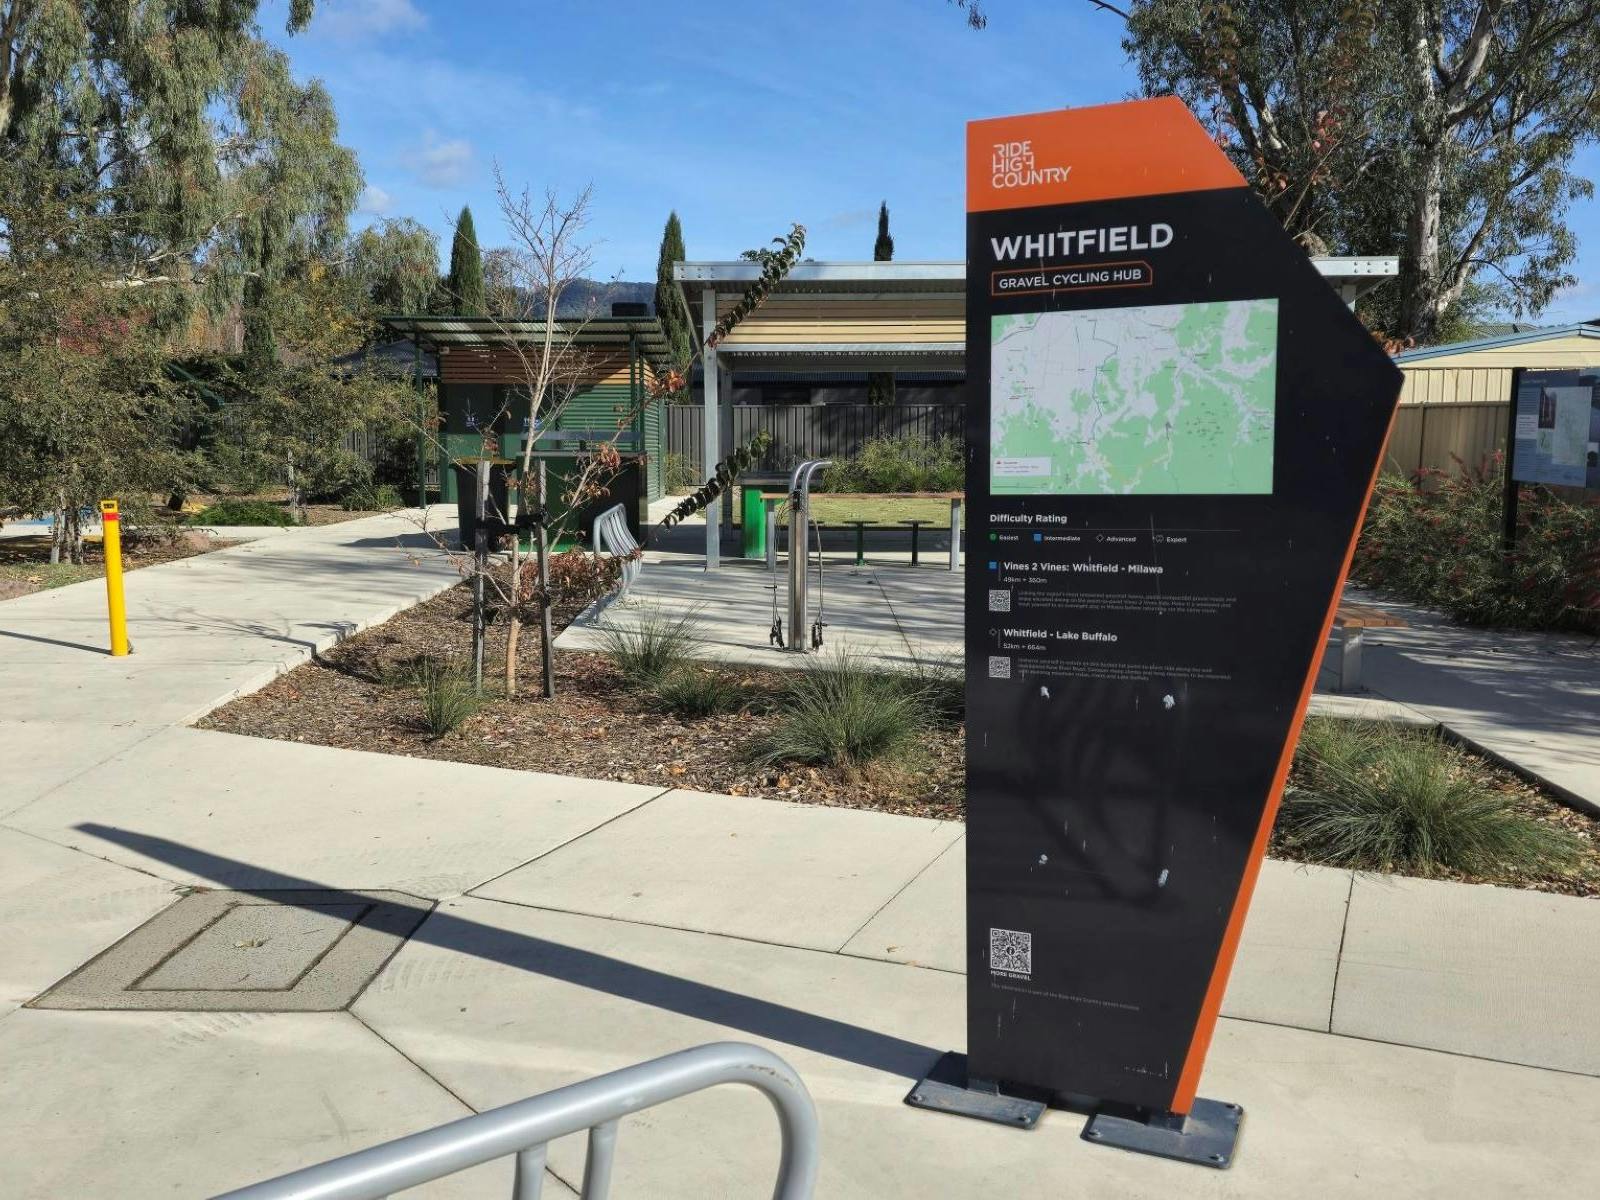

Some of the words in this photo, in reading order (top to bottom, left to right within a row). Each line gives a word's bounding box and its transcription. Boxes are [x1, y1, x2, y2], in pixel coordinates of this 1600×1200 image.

[993, 140, 1033, 157] RIDE
[992, 154, 1034, 174] HIGH
[992, 166, 1072, 188] COUNTRY
[991, 223, 1174, 261] WHITFIELD
[999, 276, 1050, 289] GRAVEL
[1053, 271, 1110, 285] CYCLING
[1113, 268, 1142, 281] HUB
[989, 513, 1034, 525] Difficulty
[1035, 514, 1068, 525] Rating
[1166, 536, 1187, 544] Expert
[1003, 561, 1030, 571] Vines
[1031, 562, 1038, 571] 2
[1040, 562, 1070, 572] Vines:
[1072, 563, 1119, 573] Whitfield
[1128, 564, 1164, 574] Milawa
[1003, 628, 1048, 639] Whitfield
[1056, 630, 1080, 640] Lake
[1081, 631, 1118, 642] Buffalo
[1009, 972, 1032, 981] GRAVEL
